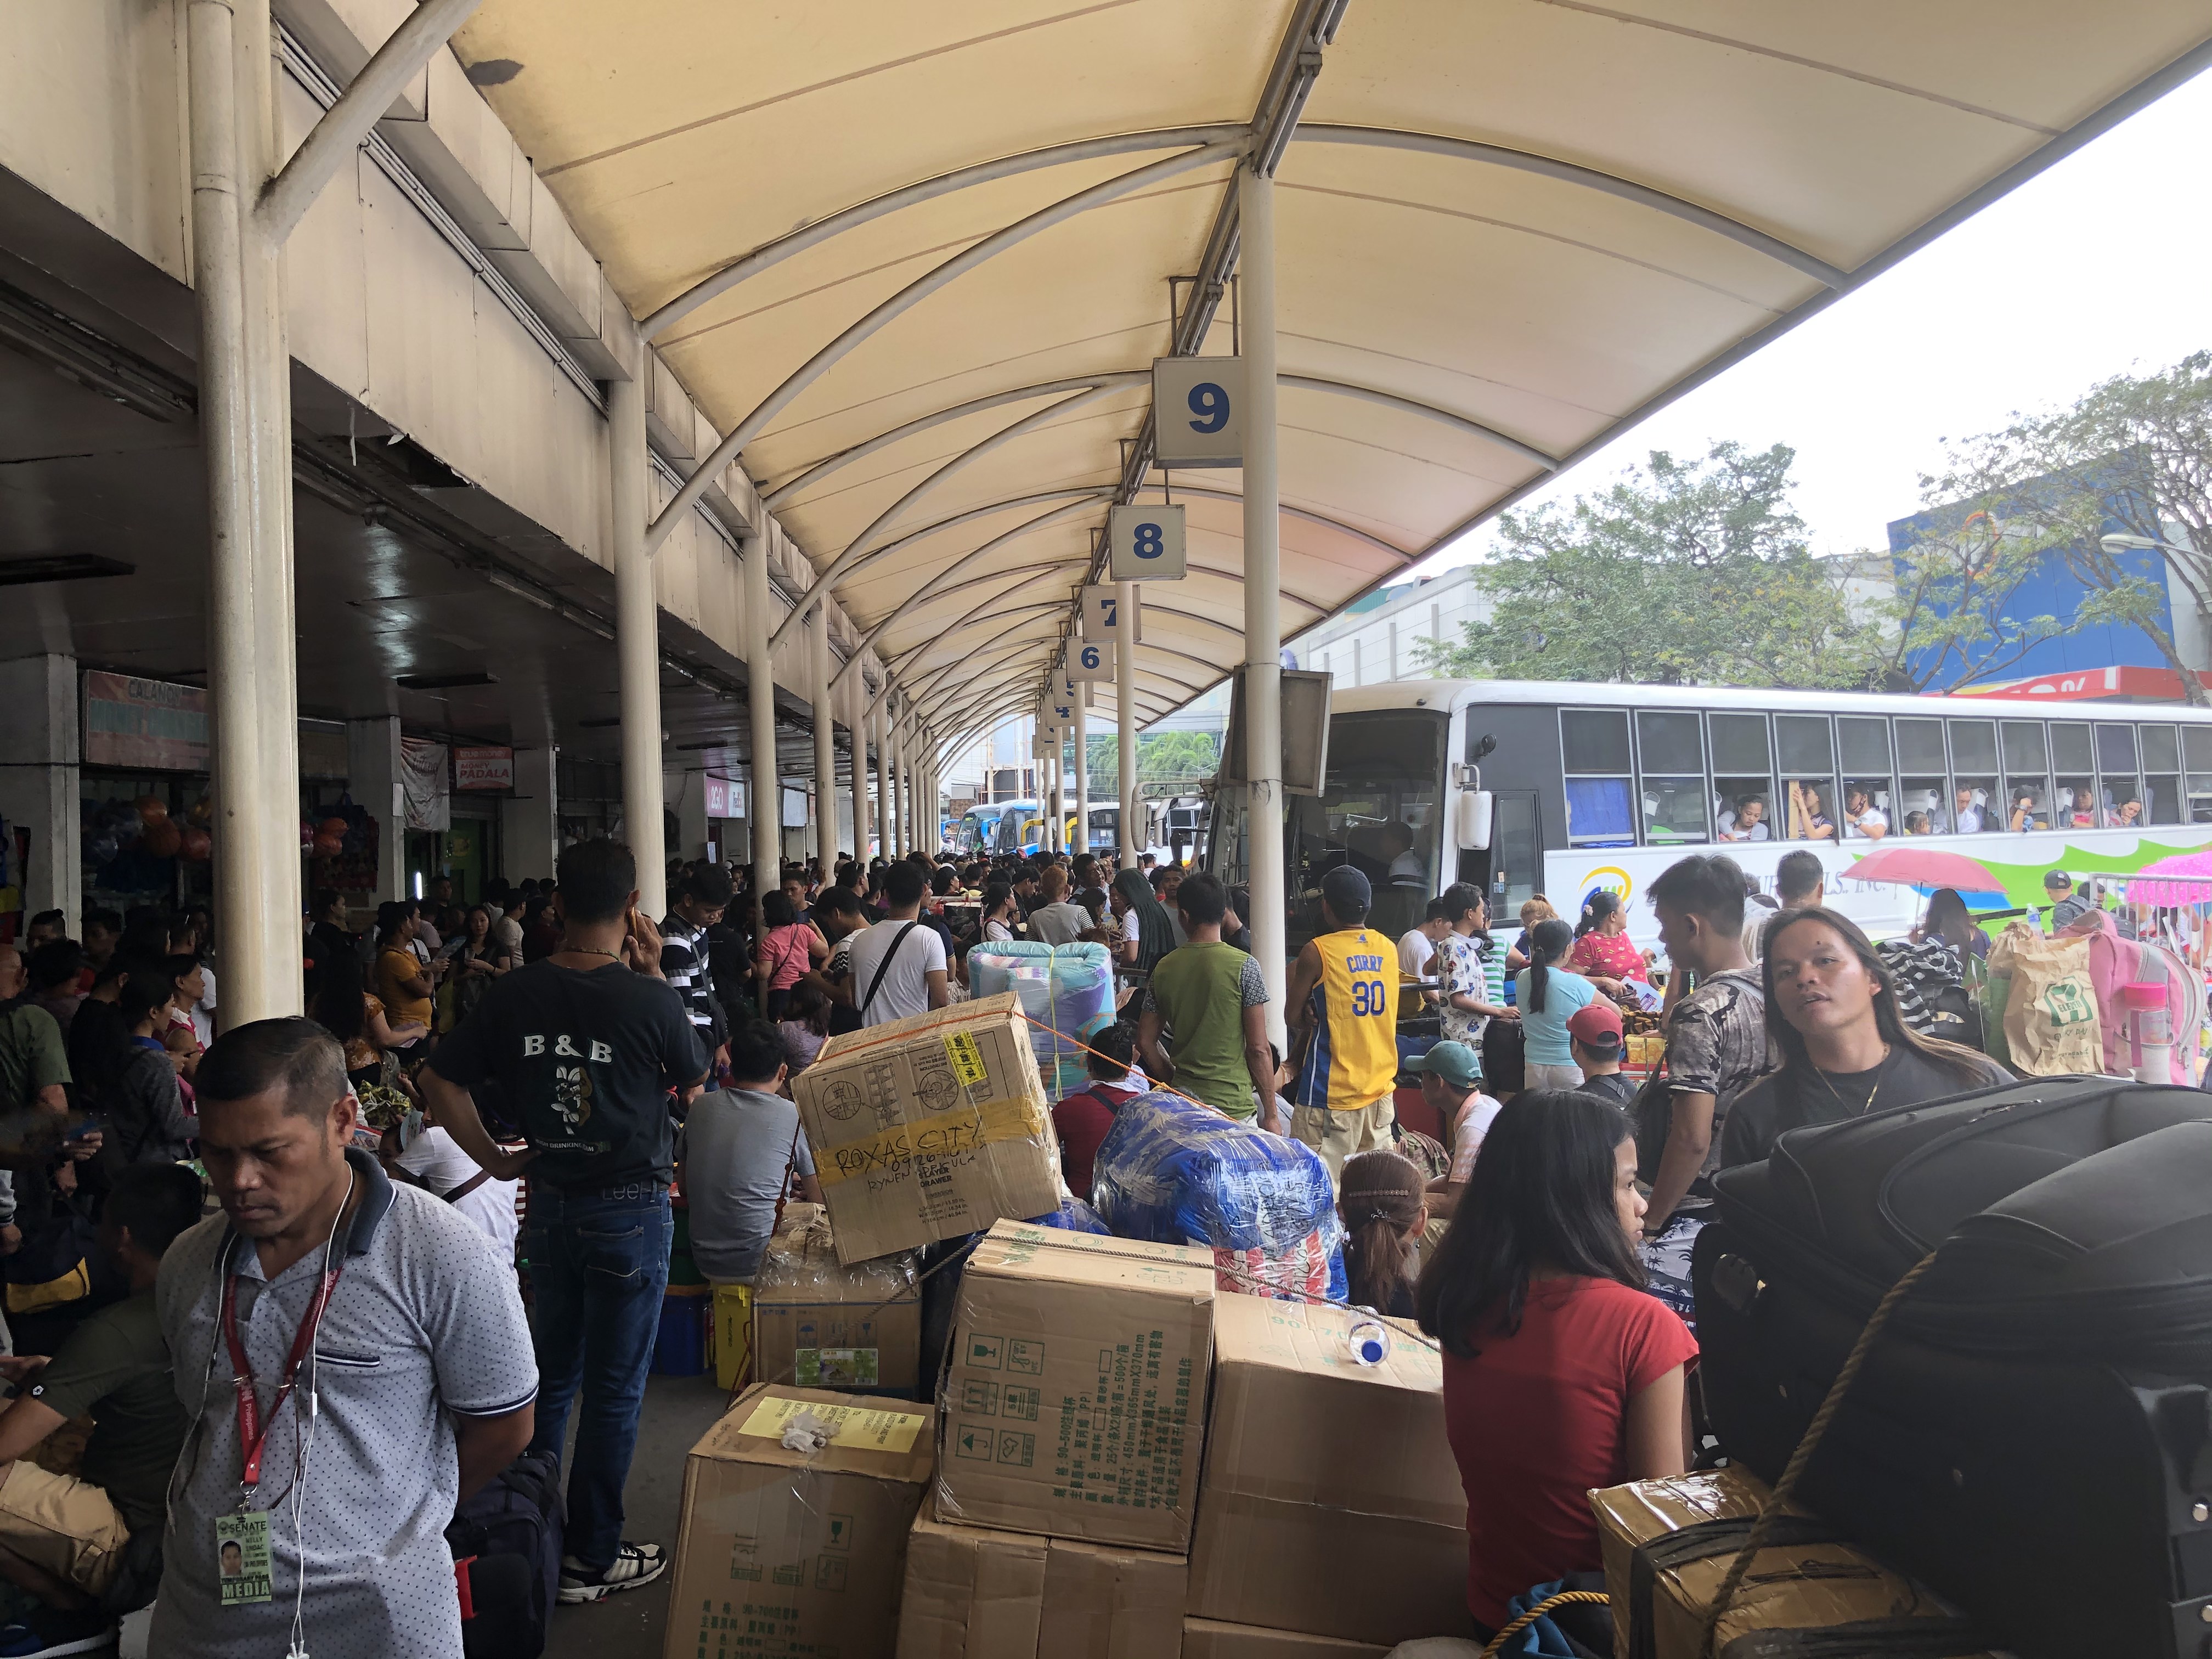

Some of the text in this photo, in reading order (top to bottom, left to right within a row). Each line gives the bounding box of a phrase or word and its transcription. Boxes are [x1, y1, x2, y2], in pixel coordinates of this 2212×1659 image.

[1188, 382, 1229, 433] 9
[1133, 523, 1164, 559] 8
[1101, 600, 1116, 627] 7
[1081, 647, 1100, 669] 6
[460, 769, 509, 778] PADALA
[711, 786, 723, 810] 2GO
[1346, 955, 1384, 973] CURRY
[1352, 980, 1385, 1017] 30
[524, 1035, 613, 1063] B & B
[835, 1115, 983, 1178] ROXAS CITY
[920, 1175, 953, 1187] DRAWER
[245, 1403, 255, 1440] Philippines
[229, 1521, 267, 1533] SENATE
[222, 1580, 270, 1598] MEDIA
